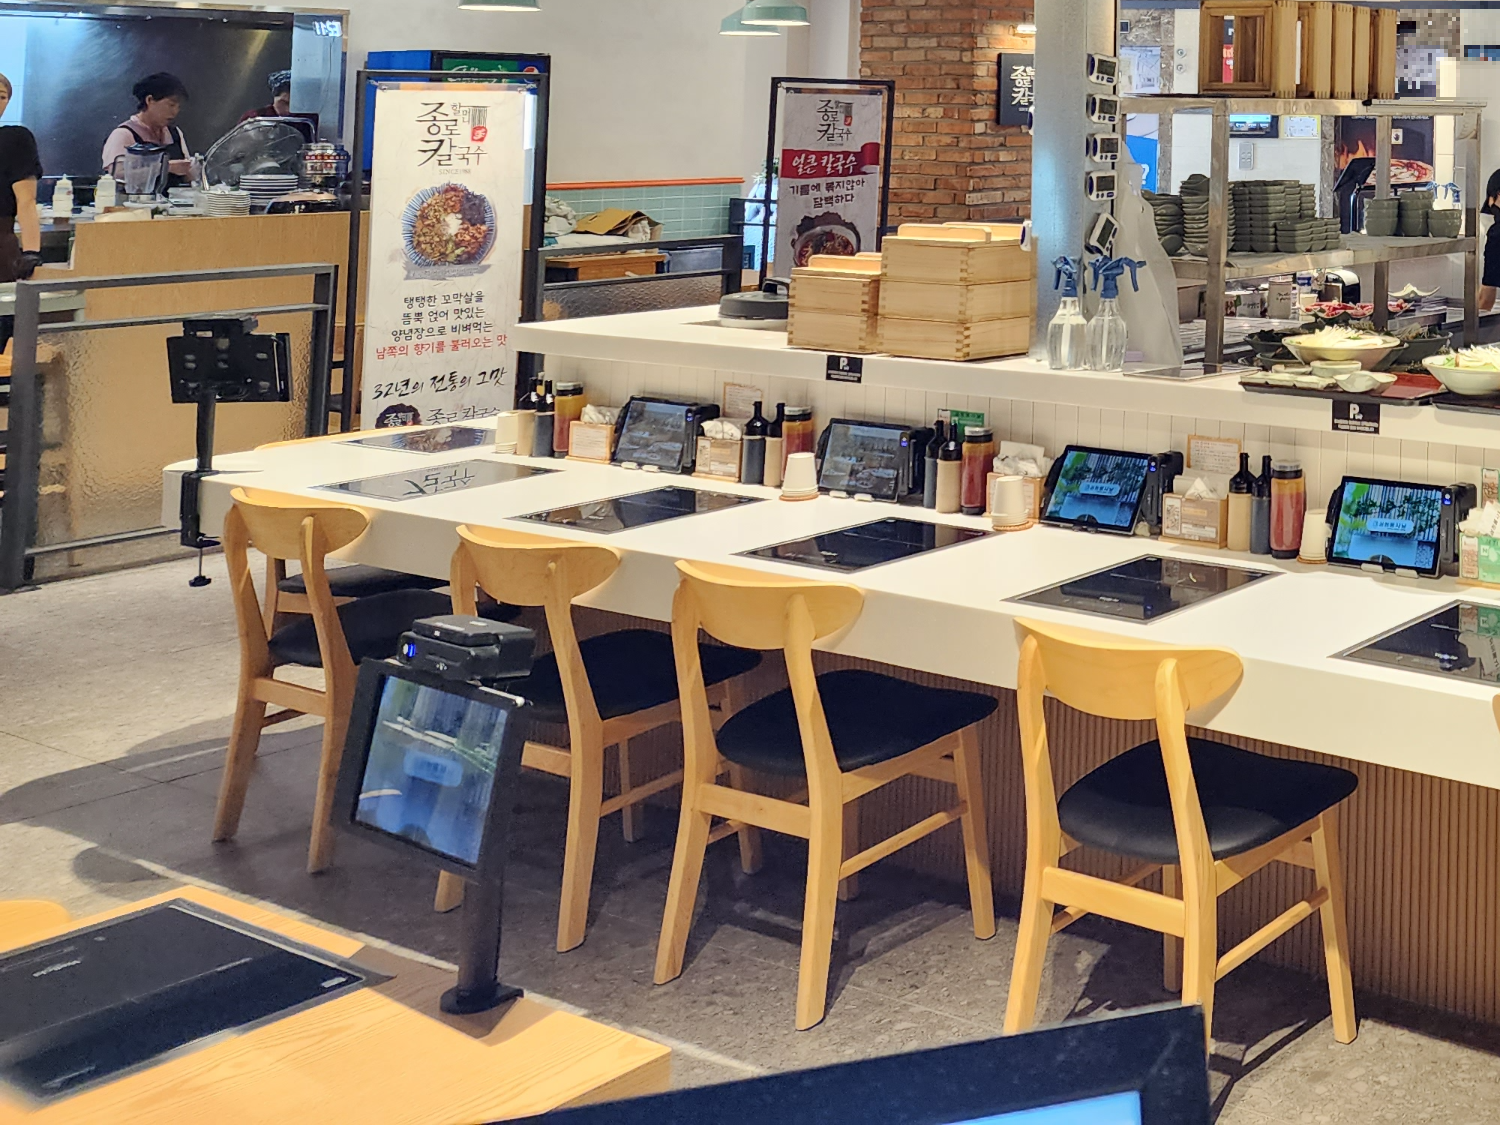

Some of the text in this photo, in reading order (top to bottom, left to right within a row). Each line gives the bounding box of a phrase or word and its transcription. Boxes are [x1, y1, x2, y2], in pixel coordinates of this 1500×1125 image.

[416, 102, 461, 135] 종로
[817, 100, 839, 122] 종로
[816, 123, 853, 142] 칼국수
[417, 137, 487, 166] 칼국수
[792, 154, 857, 175] 얼큰 칼국수
[813, 194, 855, 208] 담백하다
[404, 291, 485, 309] 탱탱한 꼬막살을
[454, 307, 485, 320] 맛있는
[391, 322, 493, 342] 양념장으로 비벼먹는
[376, 334, 507, 359] 남쪽의 향기를 불러오는 맛
[372, 378, 425, 400] 32년의
[429, 370, 472, 393] 전통의
